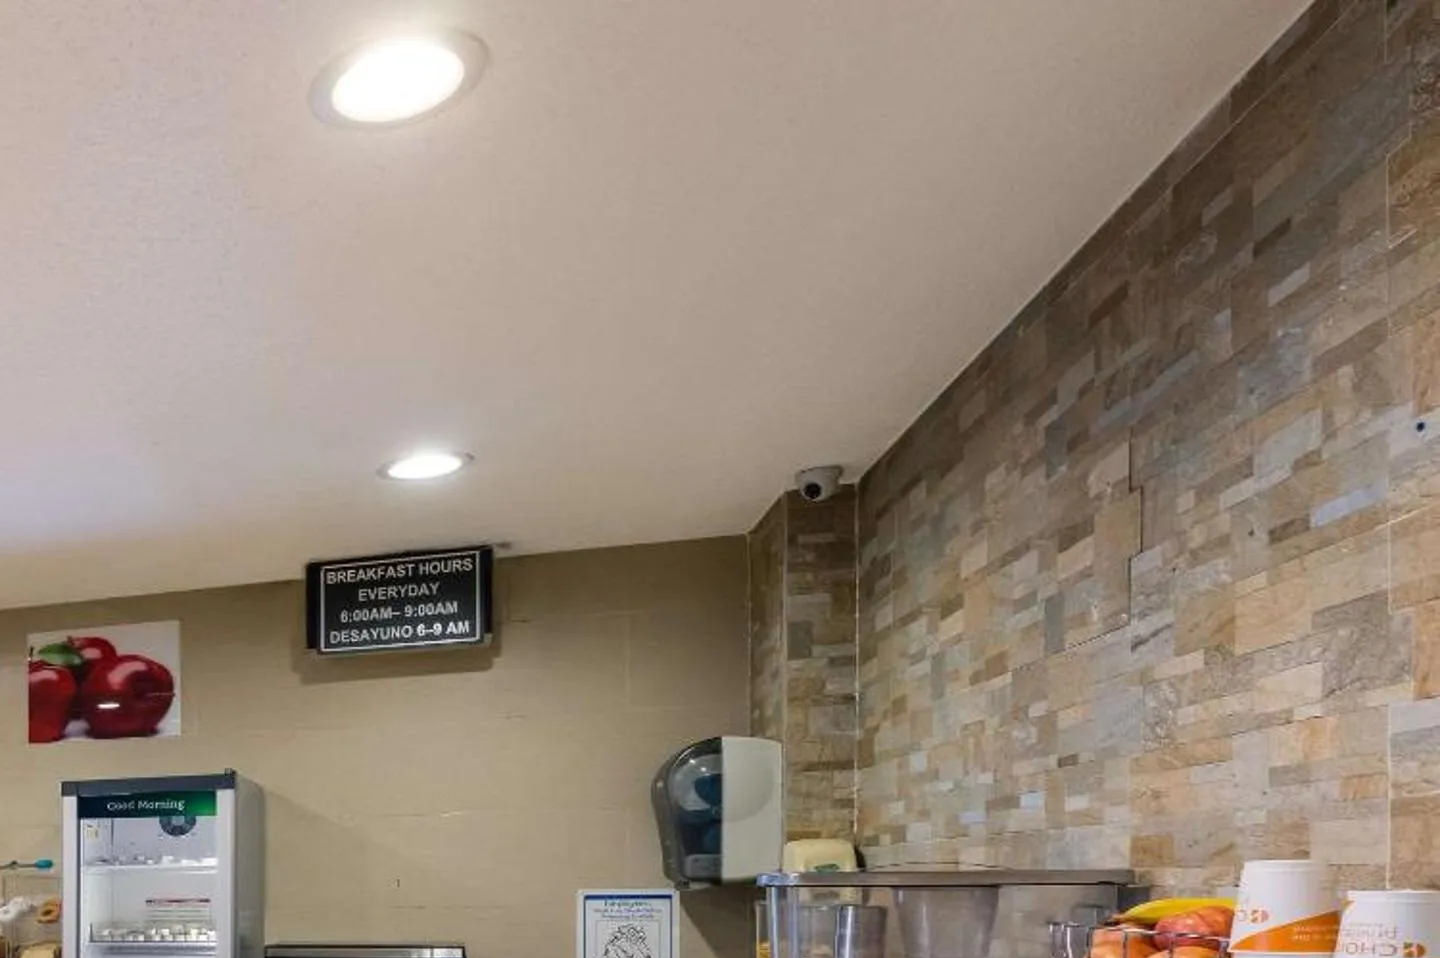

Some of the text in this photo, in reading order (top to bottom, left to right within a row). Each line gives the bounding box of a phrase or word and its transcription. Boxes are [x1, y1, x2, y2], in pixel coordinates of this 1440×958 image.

[325, 557, 474, 585] BREAKFAST HOURS
[357, 582, 441, 602] EVERYDAY
[404, 601, 458, 618] 9:00AM
[329, 620, 470, 644] DESAYUNO 6-9 AM
[137, 798, 186, 812] Morning
